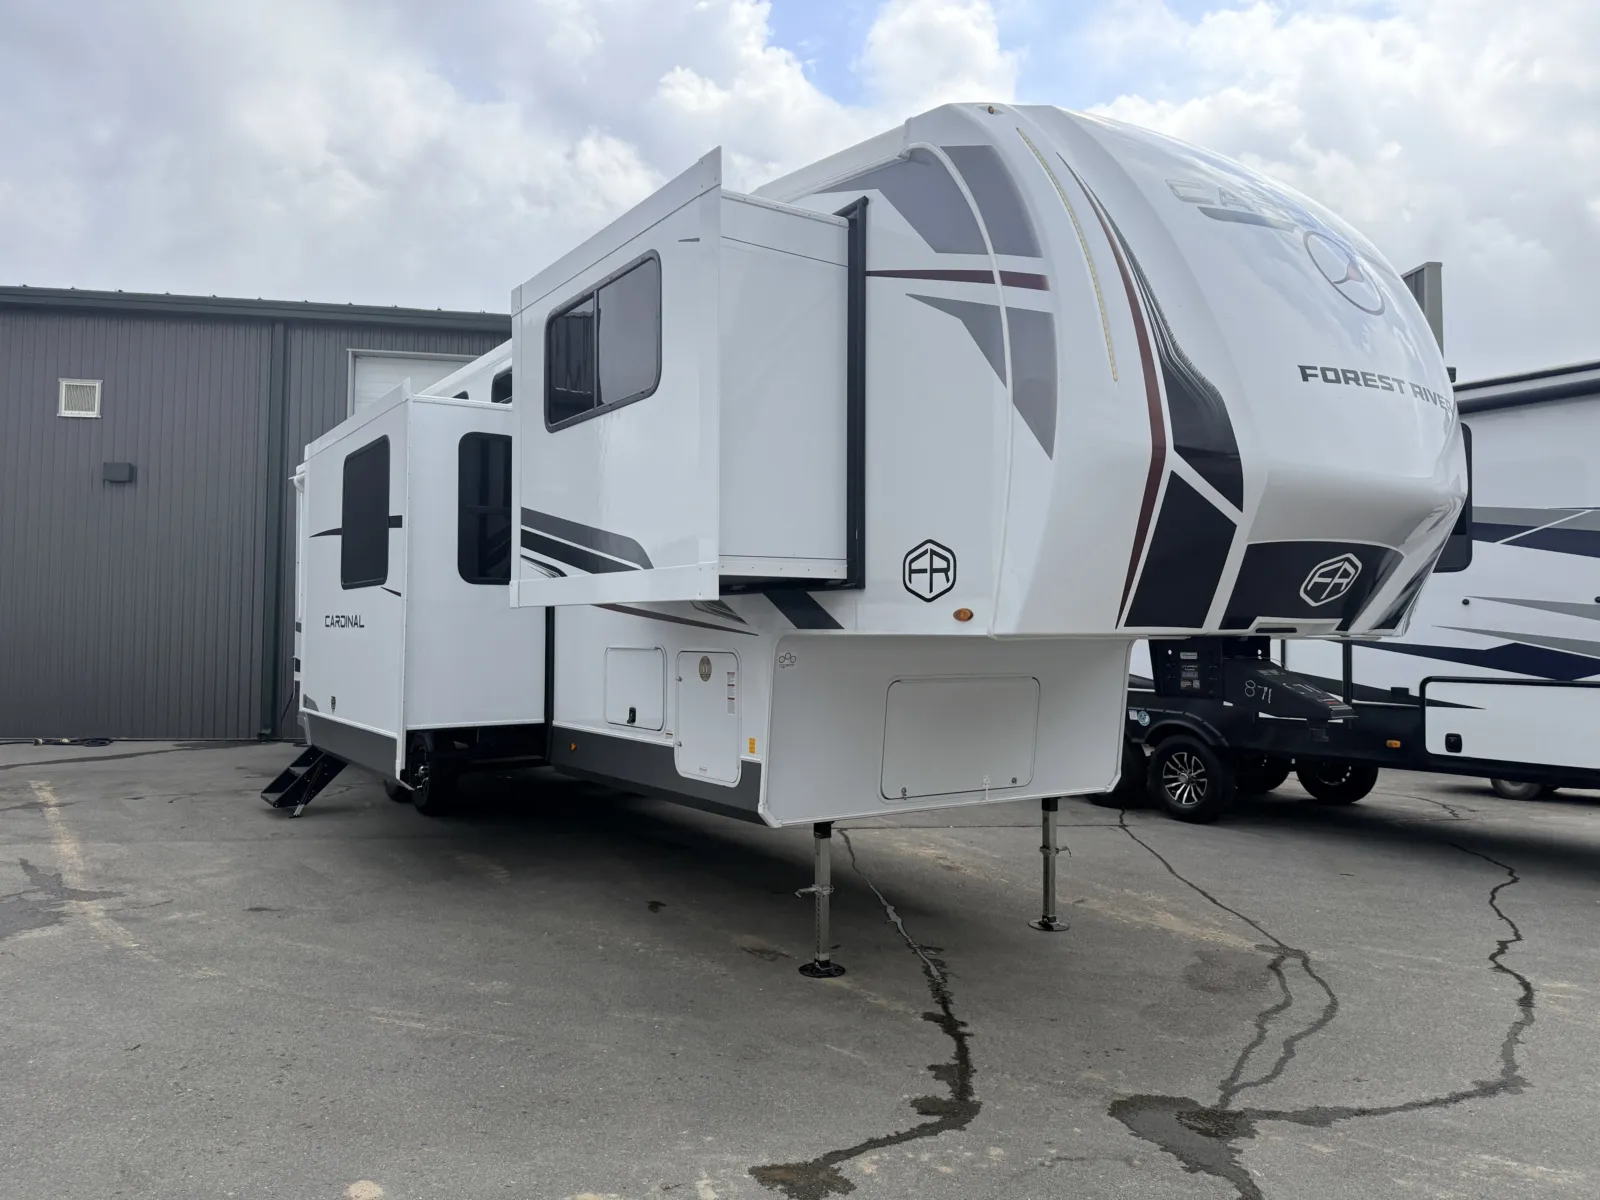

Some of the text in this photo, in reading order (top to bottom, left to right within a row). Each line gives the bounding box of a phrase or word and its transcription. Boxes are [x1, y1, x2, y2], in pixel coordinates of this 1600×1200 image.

[1297, 365, 1453, 413] FOREST RIVER
[324, 614, 365, 628] CARDINAL
[1244, 679, 1273, 704] 871
